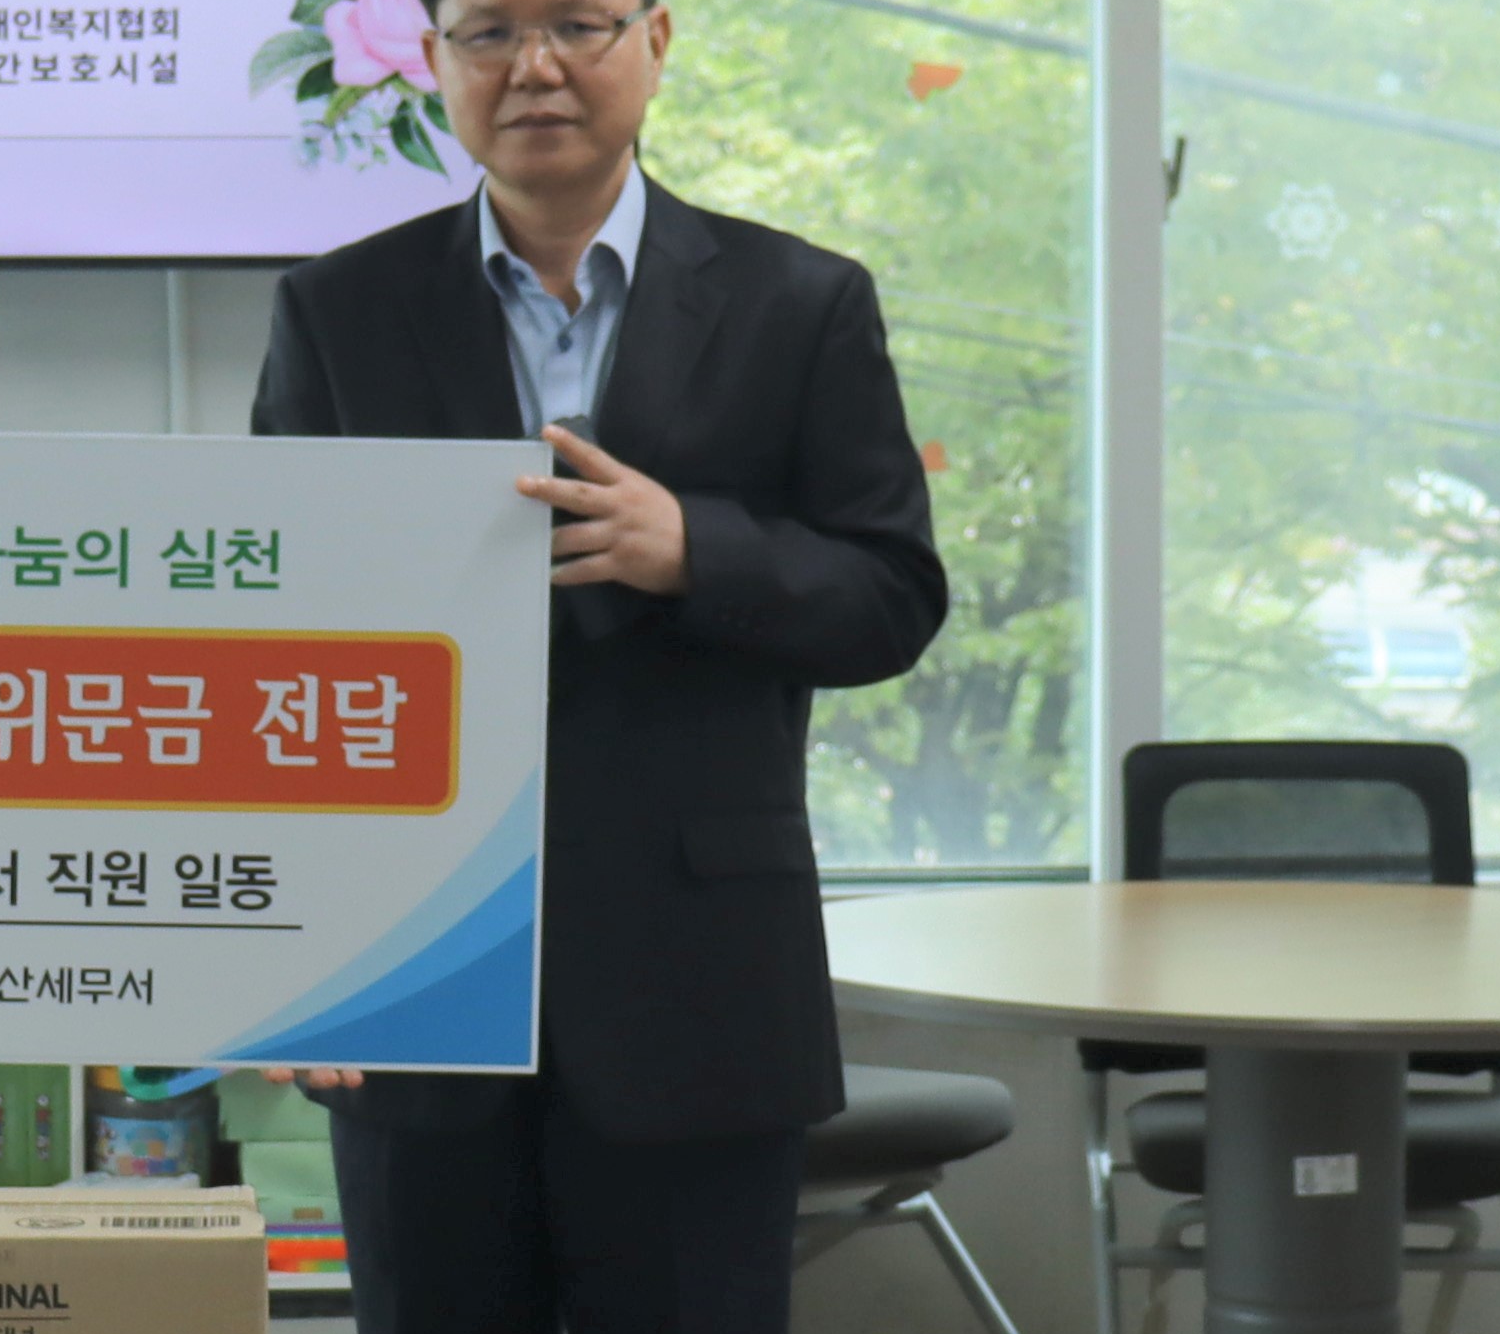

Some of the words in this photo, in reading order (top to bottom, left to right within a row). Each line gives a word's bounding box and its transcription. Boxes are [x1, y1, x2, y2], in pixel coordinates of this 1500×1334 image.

[158, 527, 282, 591] 실천
[251, 672, 408, 770] 전달
[45, 850, 147, 909] 직원
[174, 851, 278, 911] 일동
